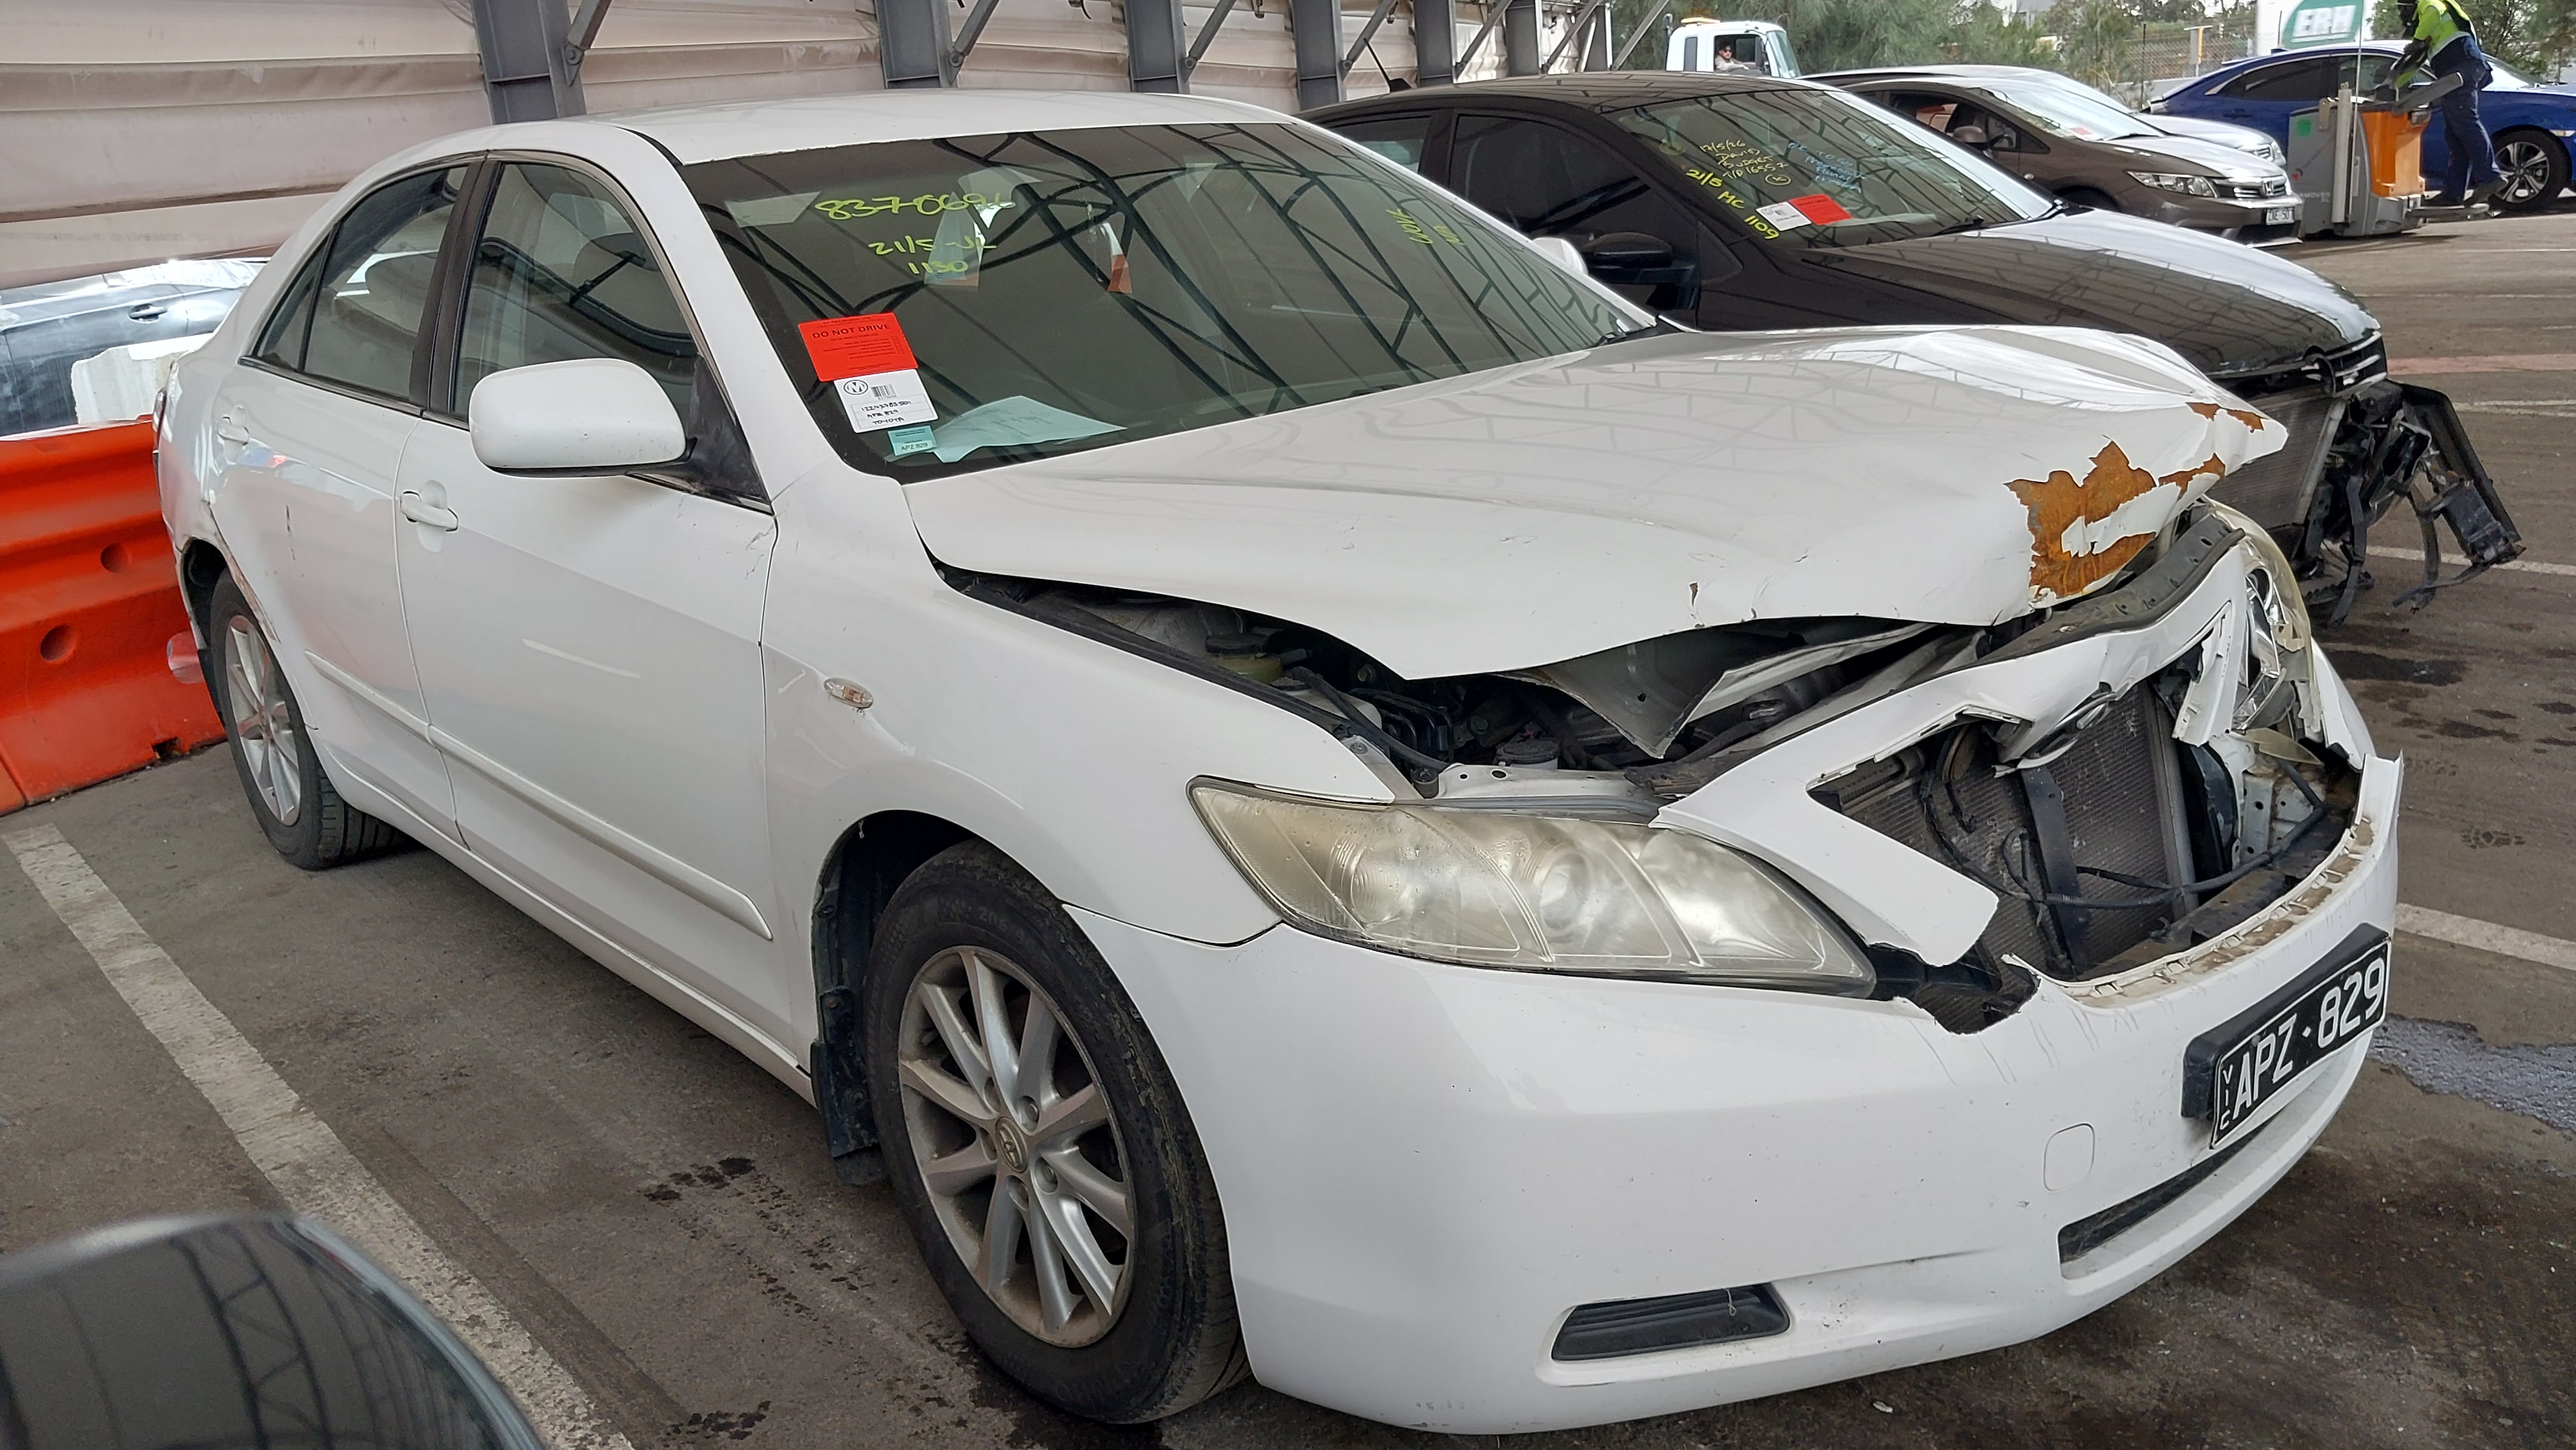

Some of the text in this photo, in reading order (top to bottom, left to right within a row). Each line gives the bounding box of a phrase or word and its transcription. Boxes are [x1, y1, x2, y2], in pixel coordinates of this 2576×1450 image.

[1686, 169, 1723, 188] 21/5
[1717, 191, 1745, 209] MC
[1744, 215, 1780, 239] 1109
[812, 331, 829, 339] DO
[833, 327, 856, 336] NOT
[859, 323, 891, 333] DRIVE
[2220, 1064, 2233, 1130] VIC
